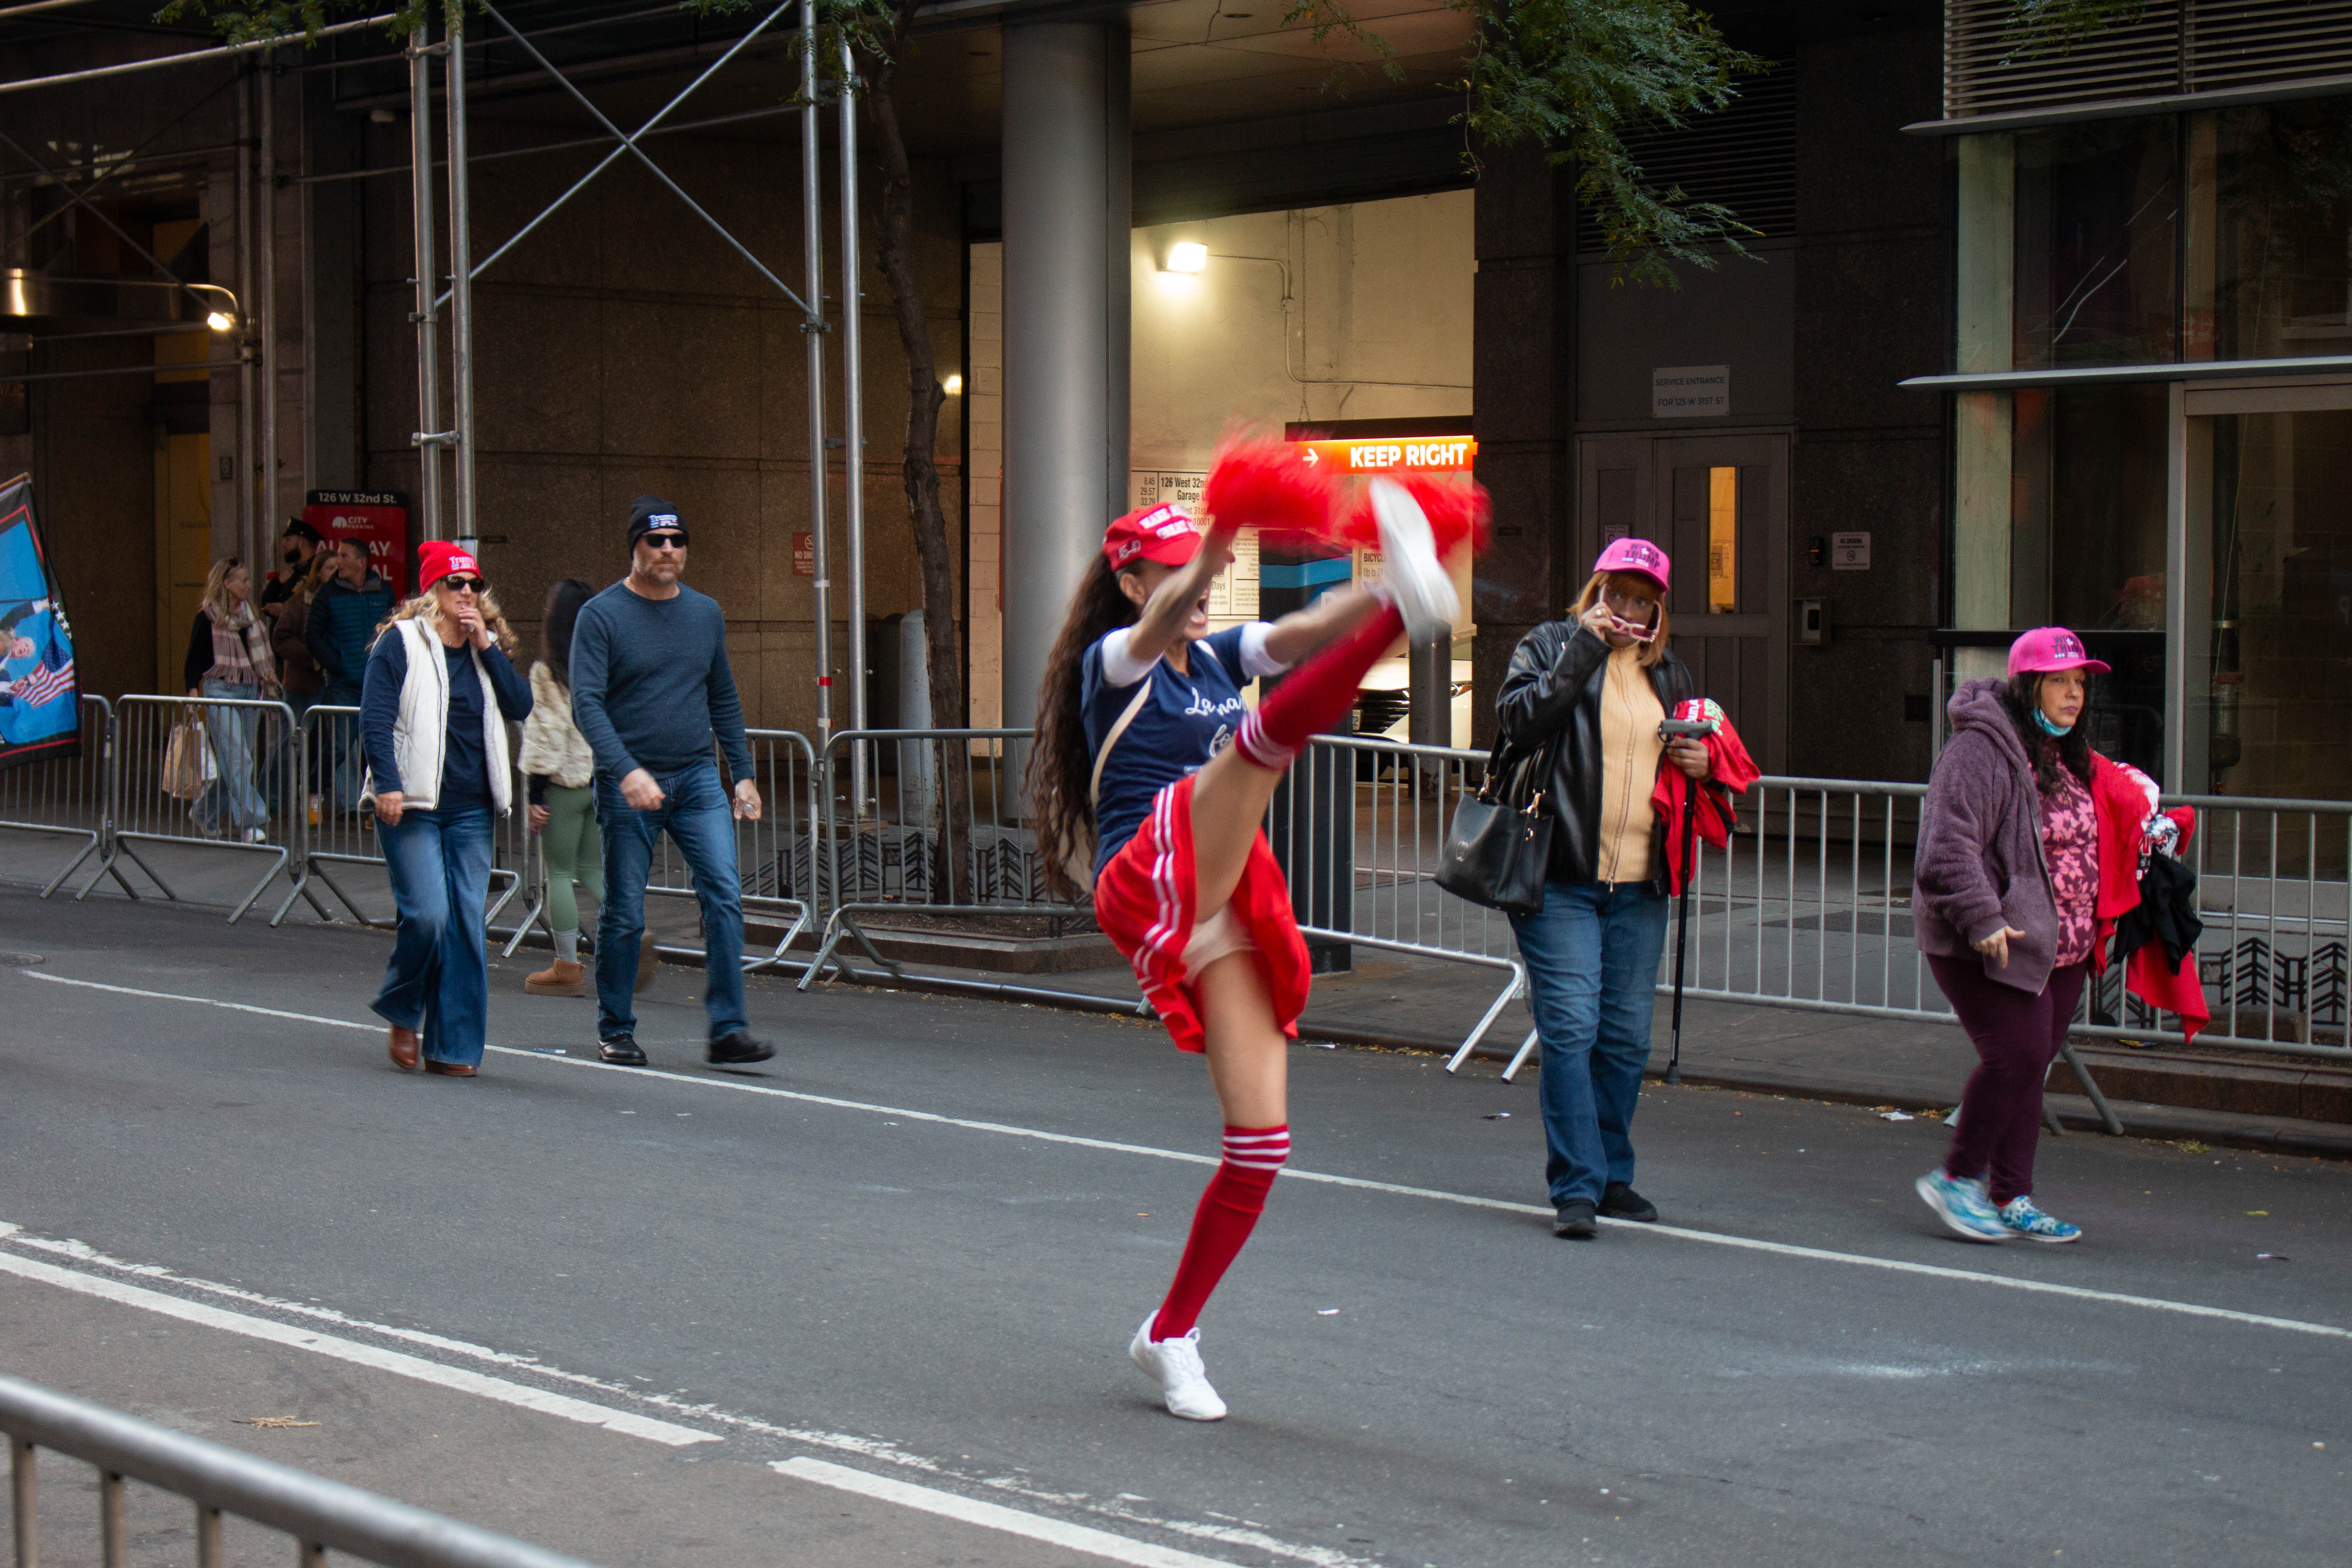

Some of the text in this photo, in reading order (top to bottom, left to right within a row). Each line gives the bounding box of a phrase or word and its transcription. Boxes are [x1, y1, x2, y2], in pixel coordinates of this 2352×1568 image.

[1686, 377, 1725, 385] ENTRANCE
[1351, 444, 1467, 467] KEEP RIGHT
[1161, 477, 1173, 487] 126
[1175, 477, 1190, 487] West
[1141, 487, 1155, 496] 29.57
[1177, 490, 1200, 502] Garage
[319, 493, 397, 503] 126 W 32nd St.
[794, 551, 802, 559] NO
[1363, 567, 1370, 578] Up
[1372, 568, 1376, 577] to
[1212, 581, 1226, 591] Days
